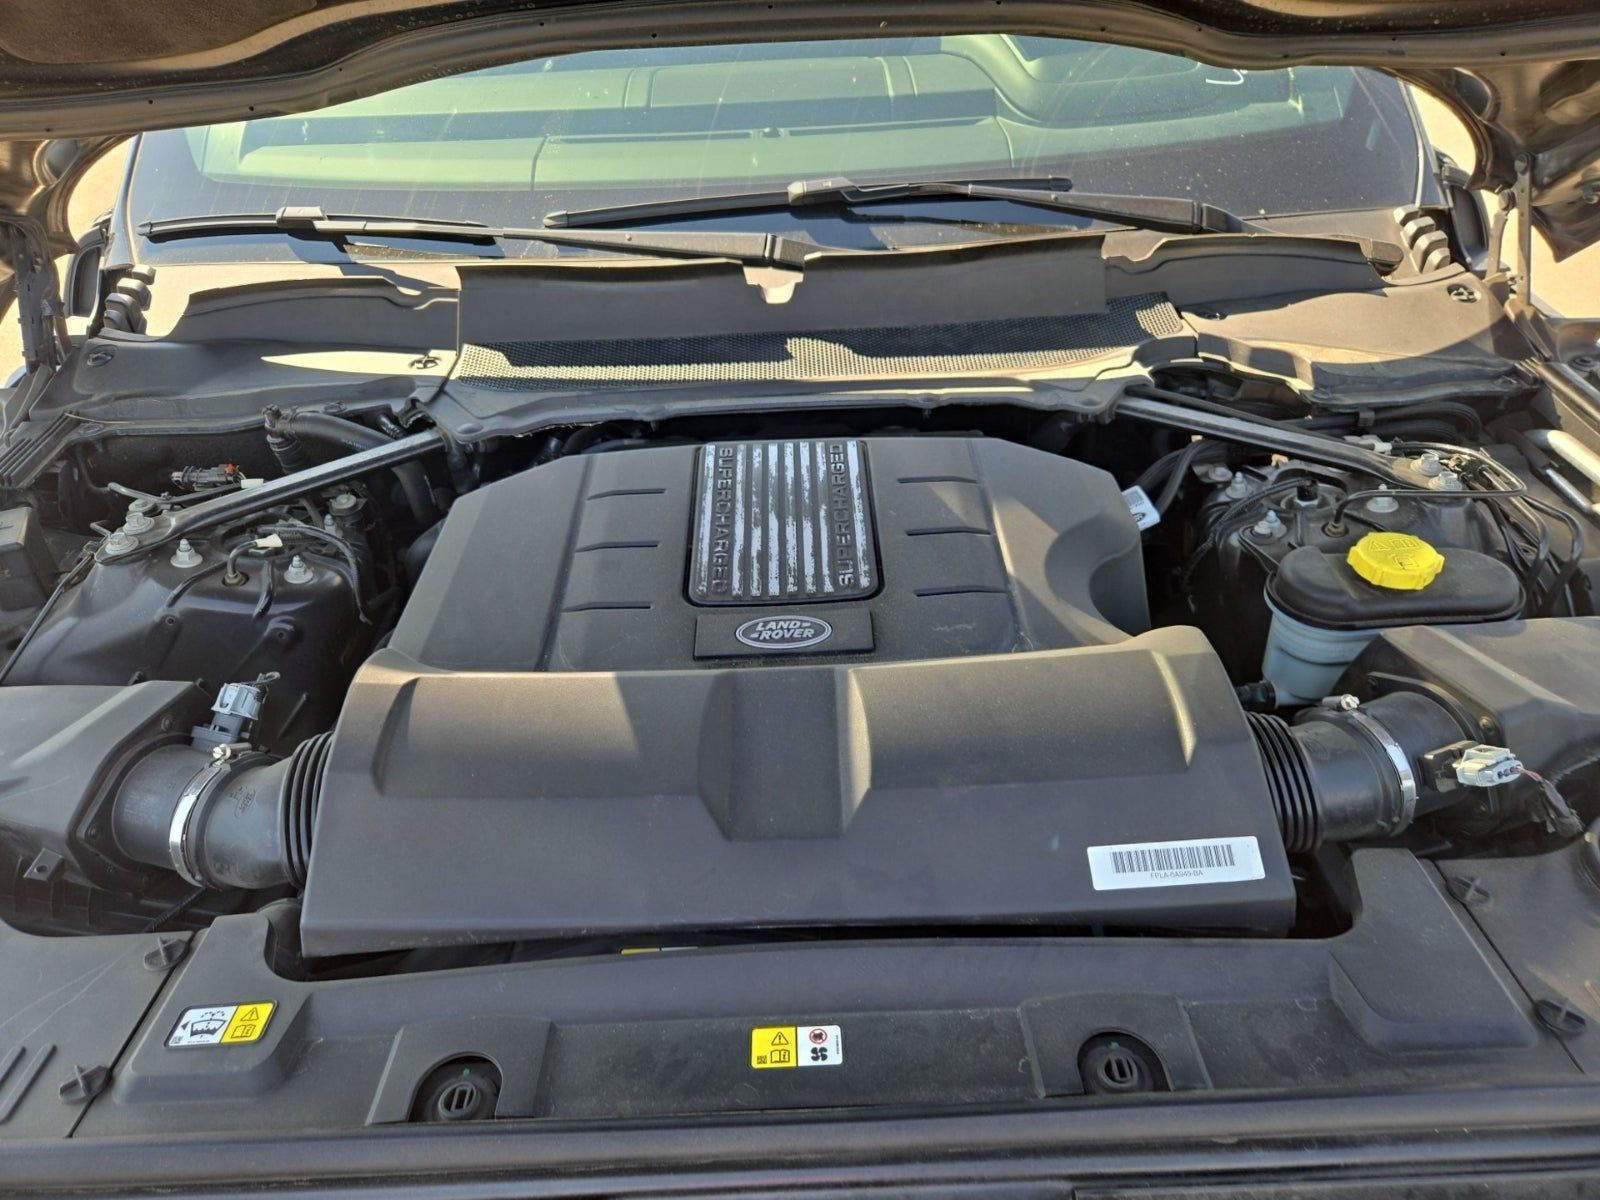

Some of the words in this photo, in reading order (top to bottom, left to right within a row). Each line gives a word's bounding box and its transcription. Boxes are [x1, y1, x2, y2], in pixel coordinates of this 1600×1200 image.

[711, 446, 733, 594] SUPERCHARGED
[829, 443, 855, 587] SUPERCHARGED
[756, 620, 800, 631] LAND
[759, 628, 815, 640] ROVER
